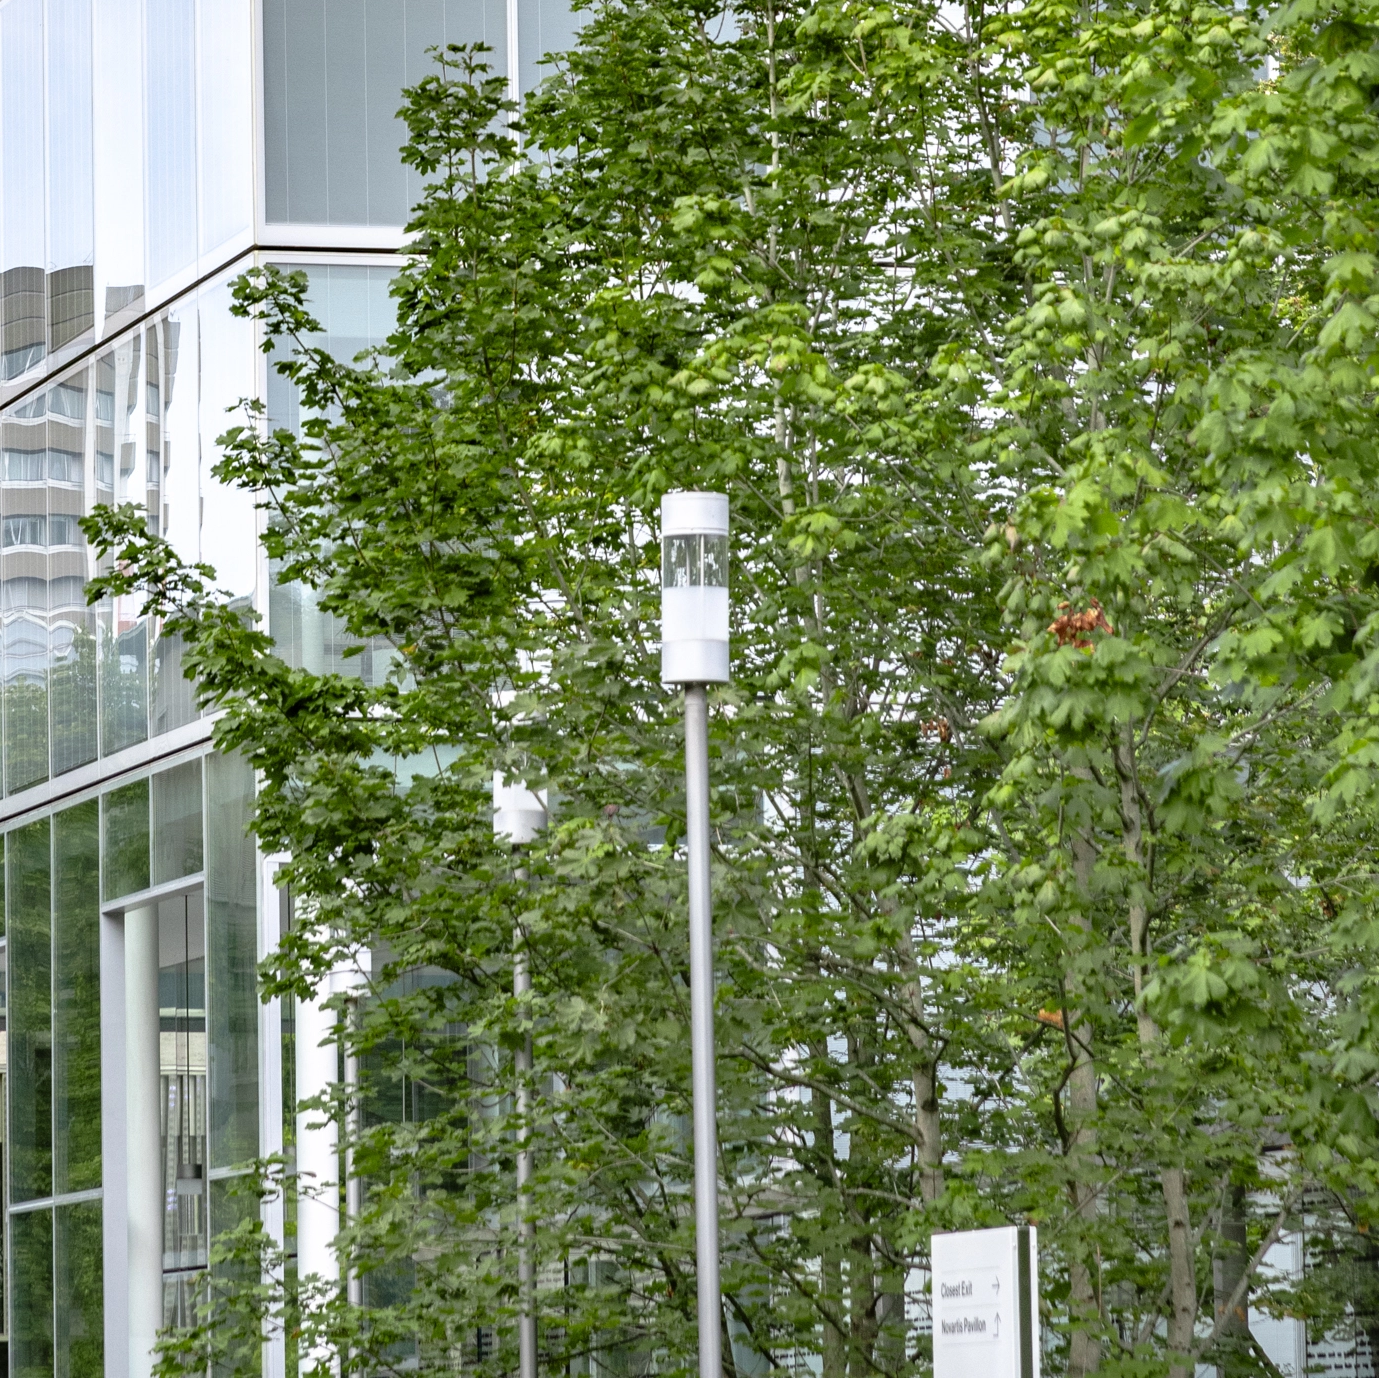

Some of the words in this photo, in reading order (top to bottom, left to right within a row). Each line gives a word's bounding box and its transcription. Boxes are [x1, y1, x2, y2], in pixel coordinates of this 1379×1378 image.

[941, 1282, 961, 1299] Closest
[961, 1280, 973, 1297] Exit
[941, 1318, 963, 1335] Novartis
